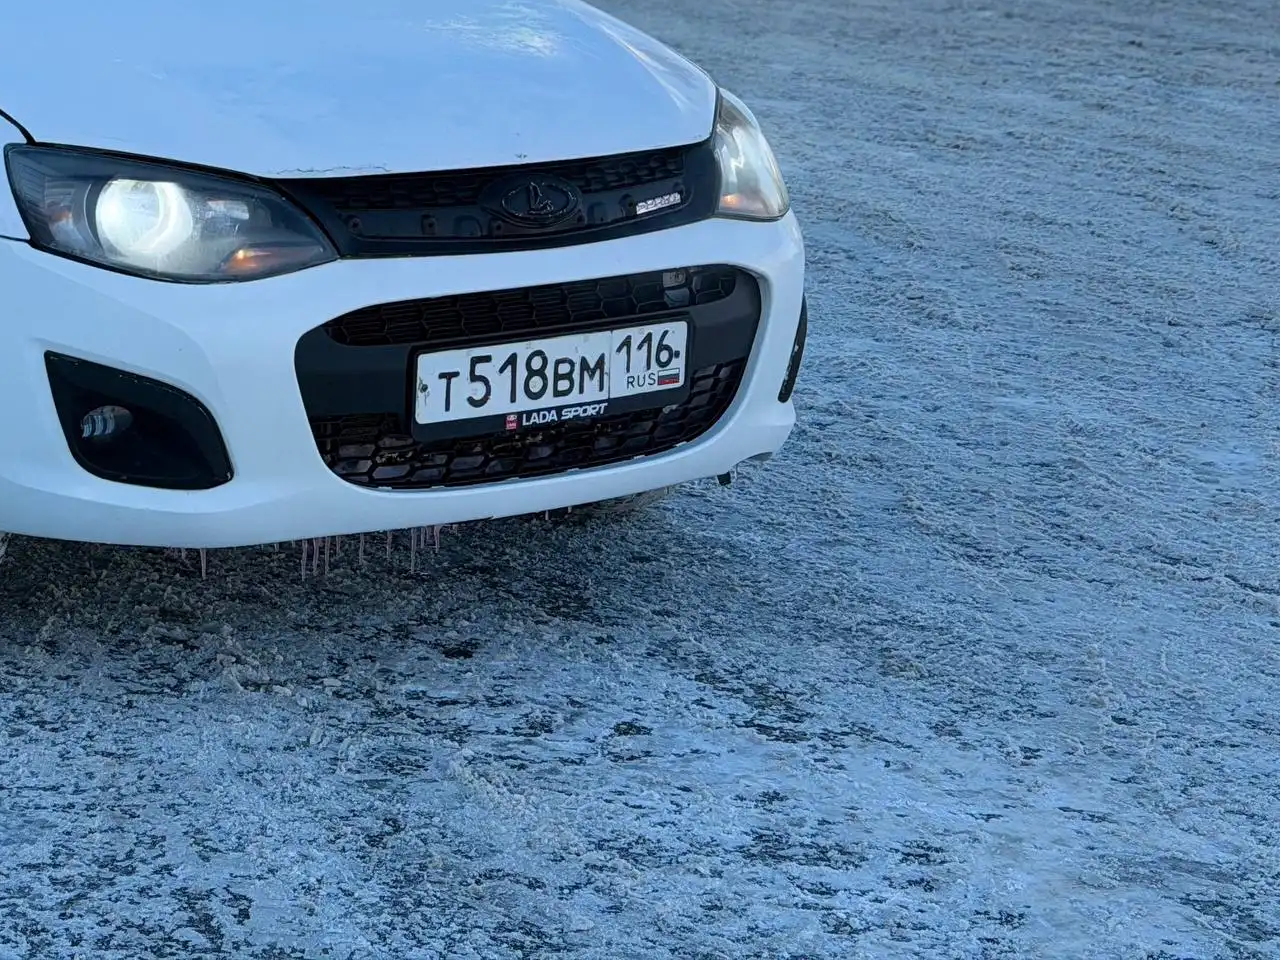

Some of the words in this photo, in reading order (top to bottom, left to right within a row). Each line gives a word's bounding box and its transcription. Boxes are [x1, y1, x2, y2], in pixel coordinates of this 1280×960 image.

[438, 348, 606, 413] Т518ВМ
[615, 329, 672, 374] 116
[625, 371, 657, 390] RUS
[521, 409, 558, 427] LADA
[561, 402, 608, 419] SPORT
